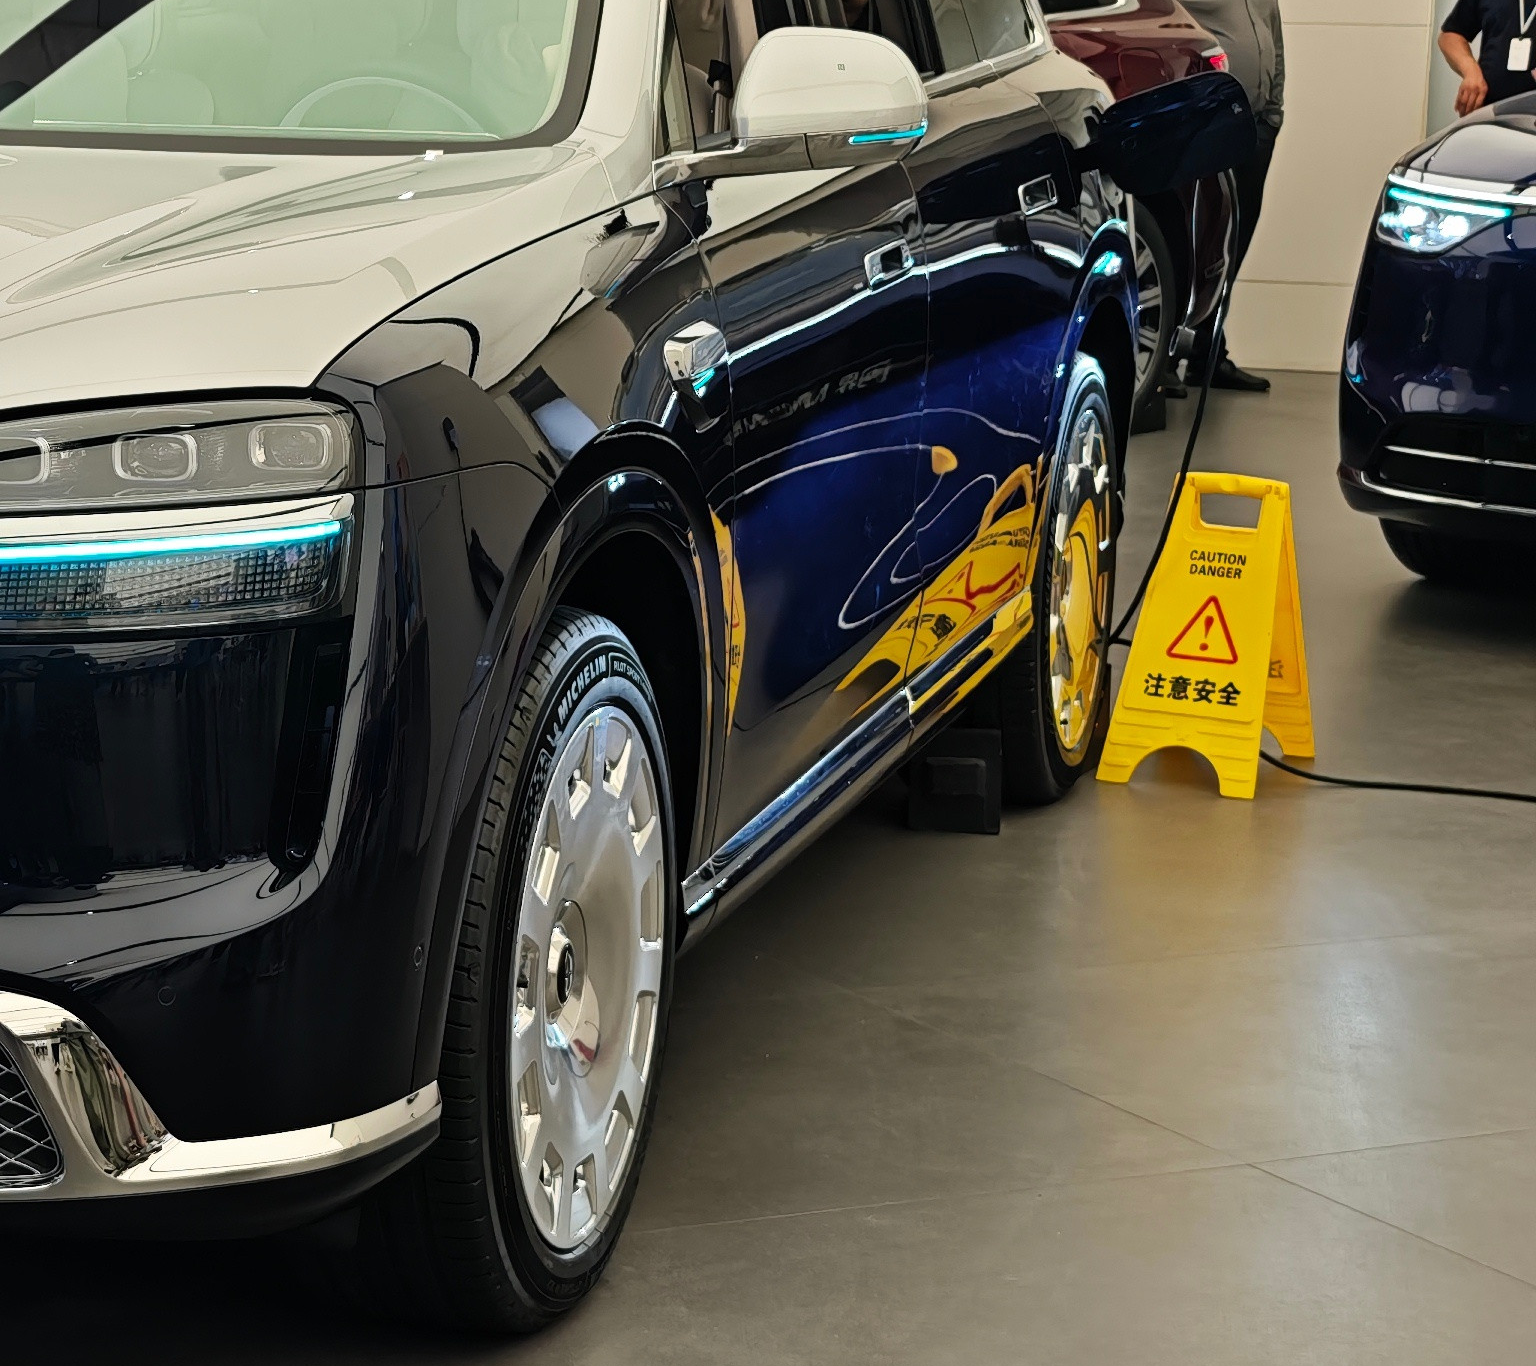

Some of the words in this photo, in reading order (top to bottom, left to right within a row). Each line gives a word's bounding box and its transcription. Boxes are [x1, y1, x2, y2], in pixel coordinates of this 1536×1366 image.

[1189, 549, 1247, 566] CAUTION
[1188, 563, 1243, 580] DANGER
[557, 654, 607, 725] MICHELIN
[1143, 672, 1242, 707] 注意安全
